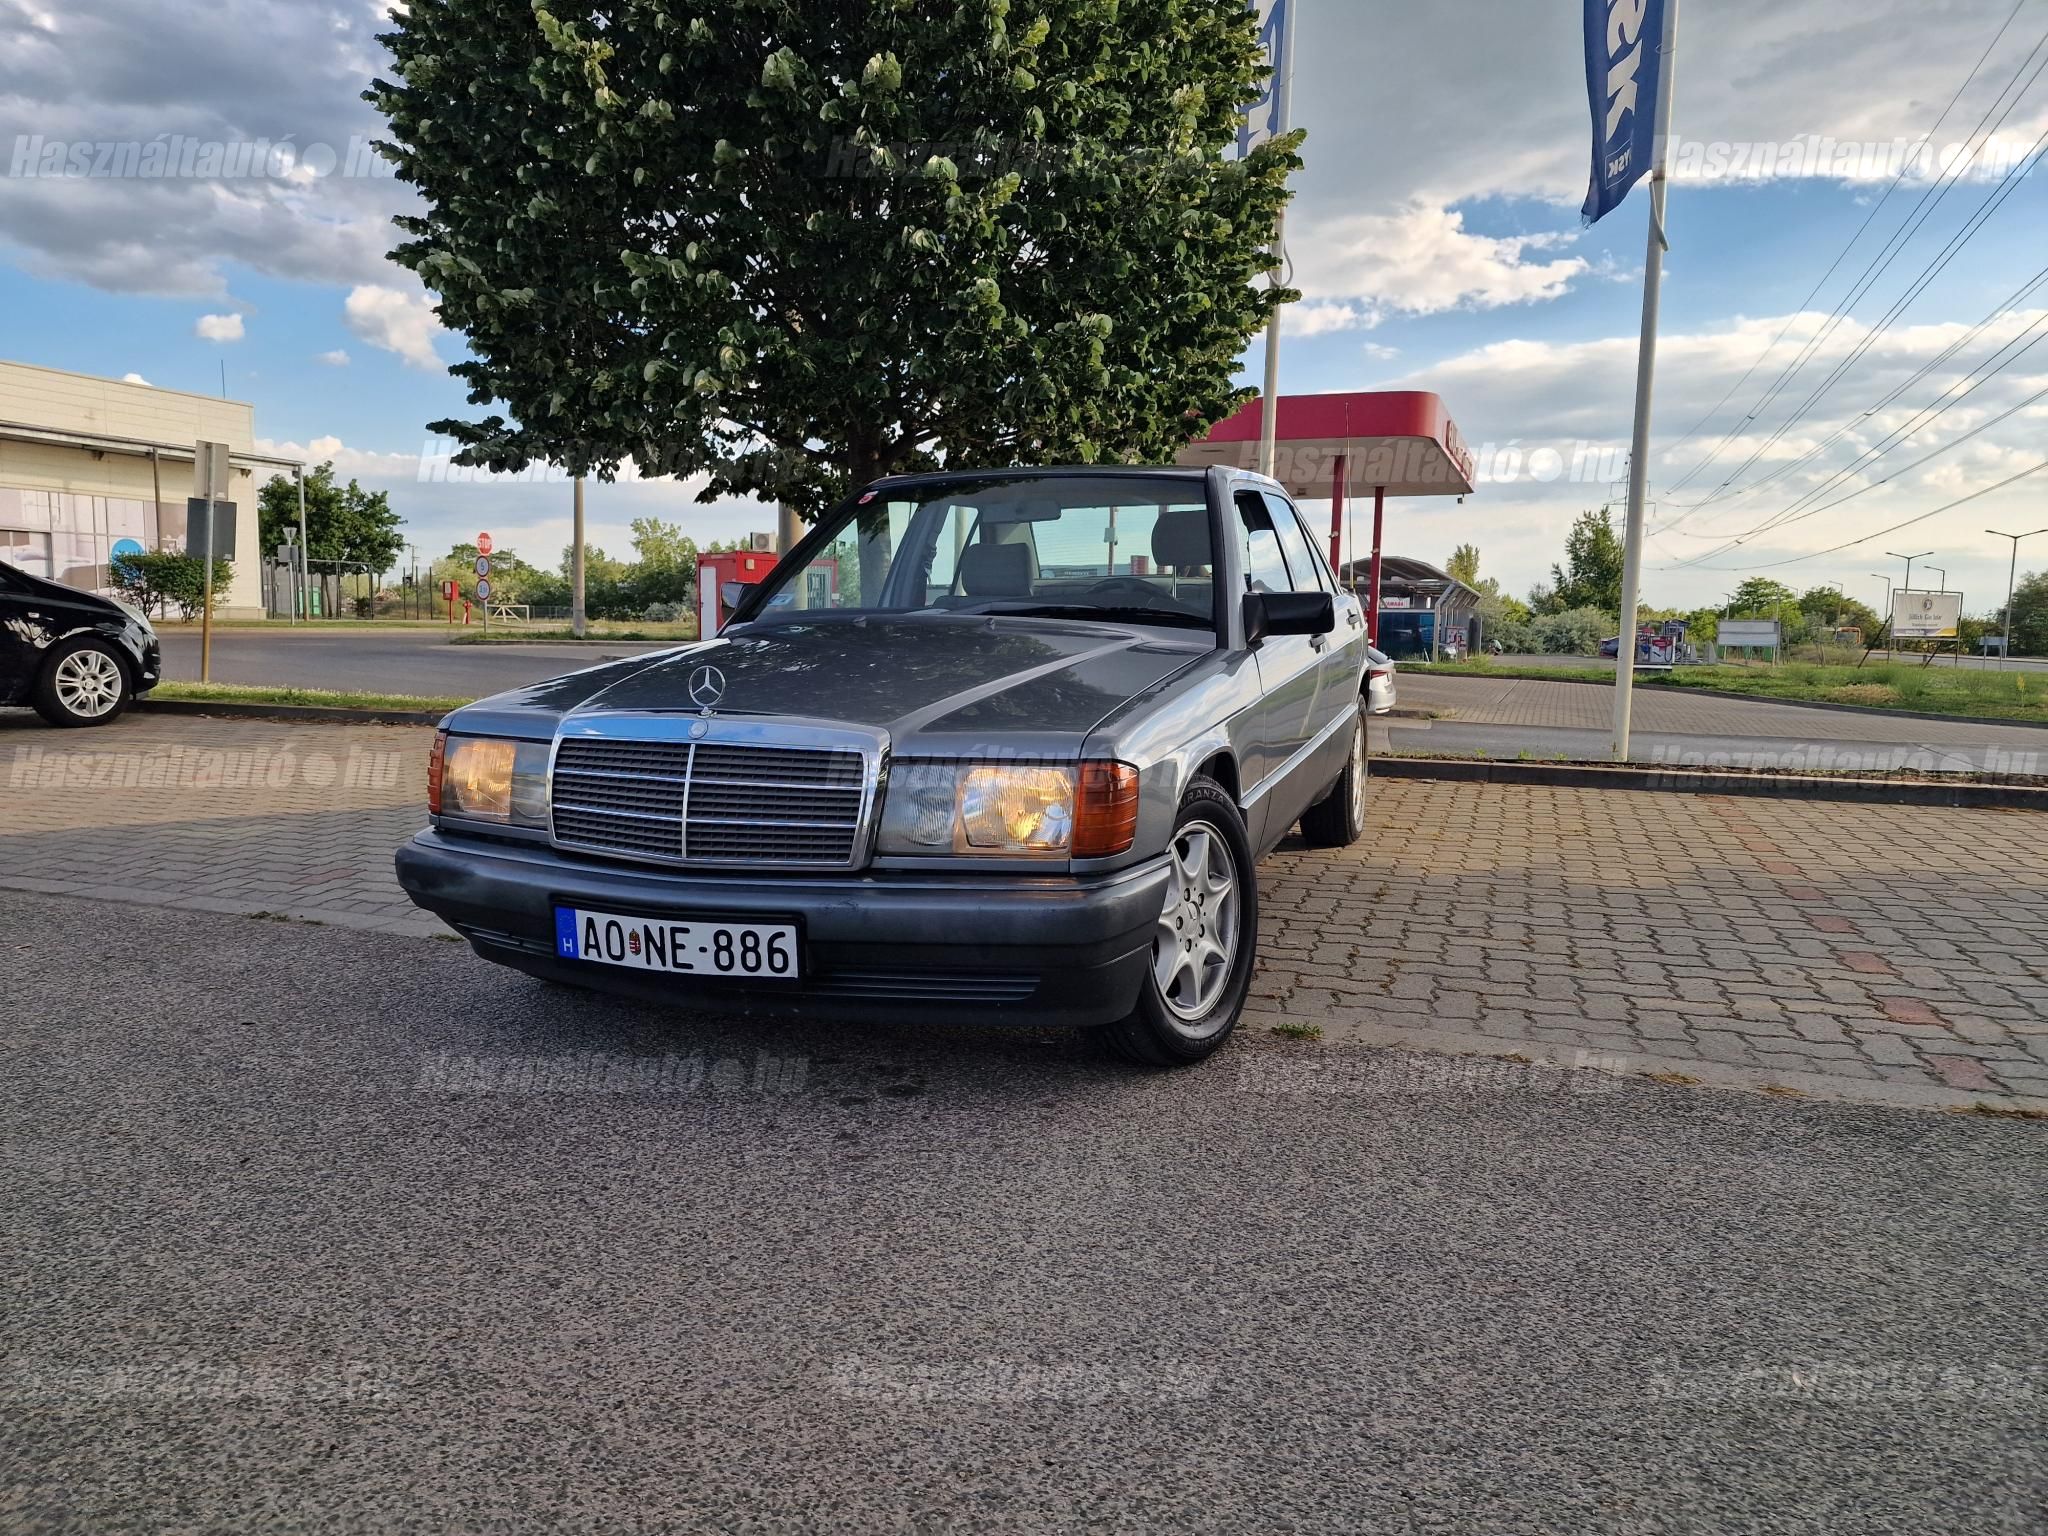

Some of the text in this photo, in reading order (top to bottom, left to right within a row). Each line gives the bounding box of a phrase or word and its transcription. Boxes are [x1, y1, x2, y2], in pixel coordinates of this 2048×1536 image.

[477, 538, 492, 548] STOP
[1179, 788, 1225, 810] URANZA
[562, 938, 574, 953] H
